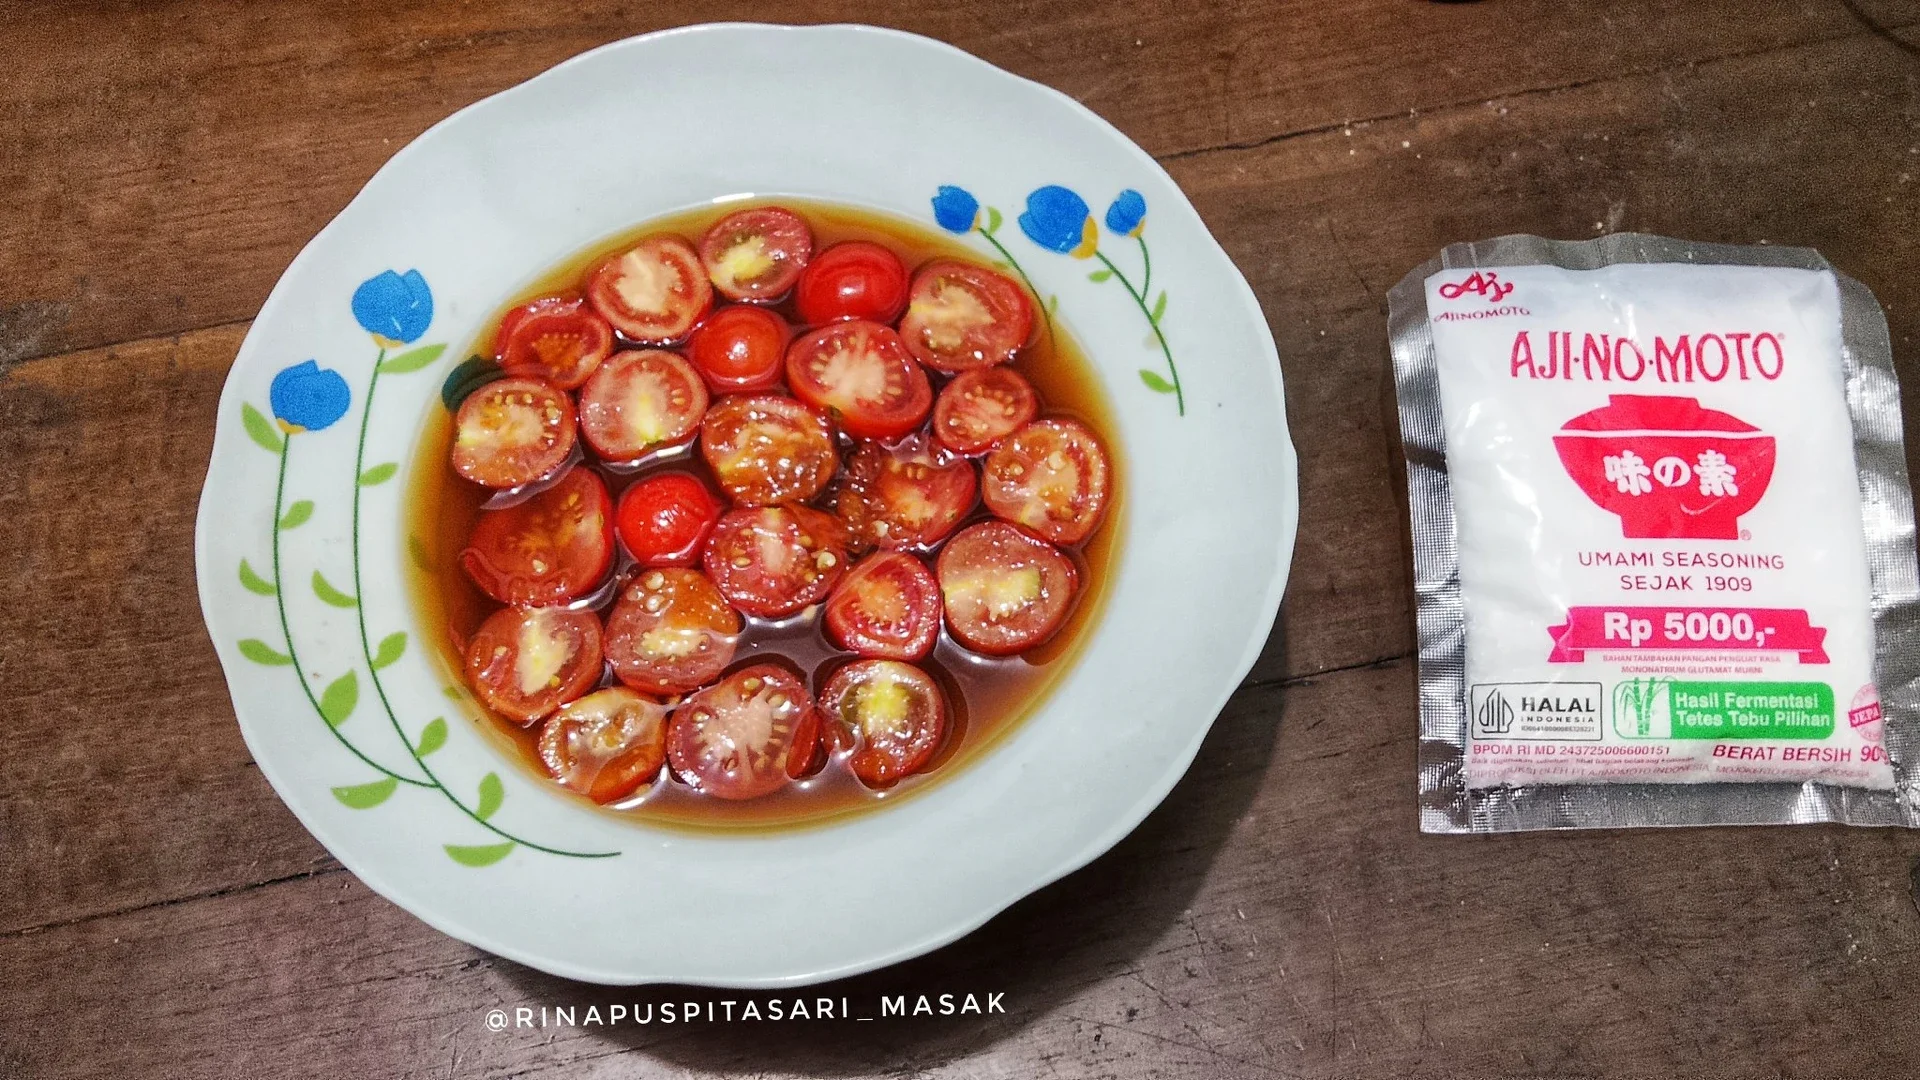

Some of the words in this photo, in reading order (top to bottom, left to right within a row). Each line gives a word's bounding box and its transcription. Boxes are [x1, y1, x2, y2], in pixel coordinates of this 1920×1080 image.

[1433, 305, 1531, 322] AJINOMOTO
[1602, 449, 1739, 497] 味の素
[1578, 551, 1654, 567] UMAMI
[1662, 551, 1785, 570] SEASONING
[1620, 575, 1694, 591] SEJAK
[1705, 576, 1753, 592] 1909
[1604, 612, 1651, 646] Rp
[1664, 612, 1776, 646] 5000,-
[1521, 697, 1595, 713] HALAL
[1675, 692, 1719, 708] Hasil
[1724, 692, 1819, 709] Fermentasi
[1676, 710, 1723, 727] Tetes
[1728, 710, 1770, 727] Tebu
[1775, 711, 1830, 727] Pilihan
[1473, 744, 1513, 755] BPOM
[1517, 744, 1531, 755] RI
[1535, 745, 1556, 755] MD
[1559, 745, 1670, 756] 243725006600151
[1712, 744, 1777, 761] BERAT
[1782, 747, 1851, 762] BERSIH
